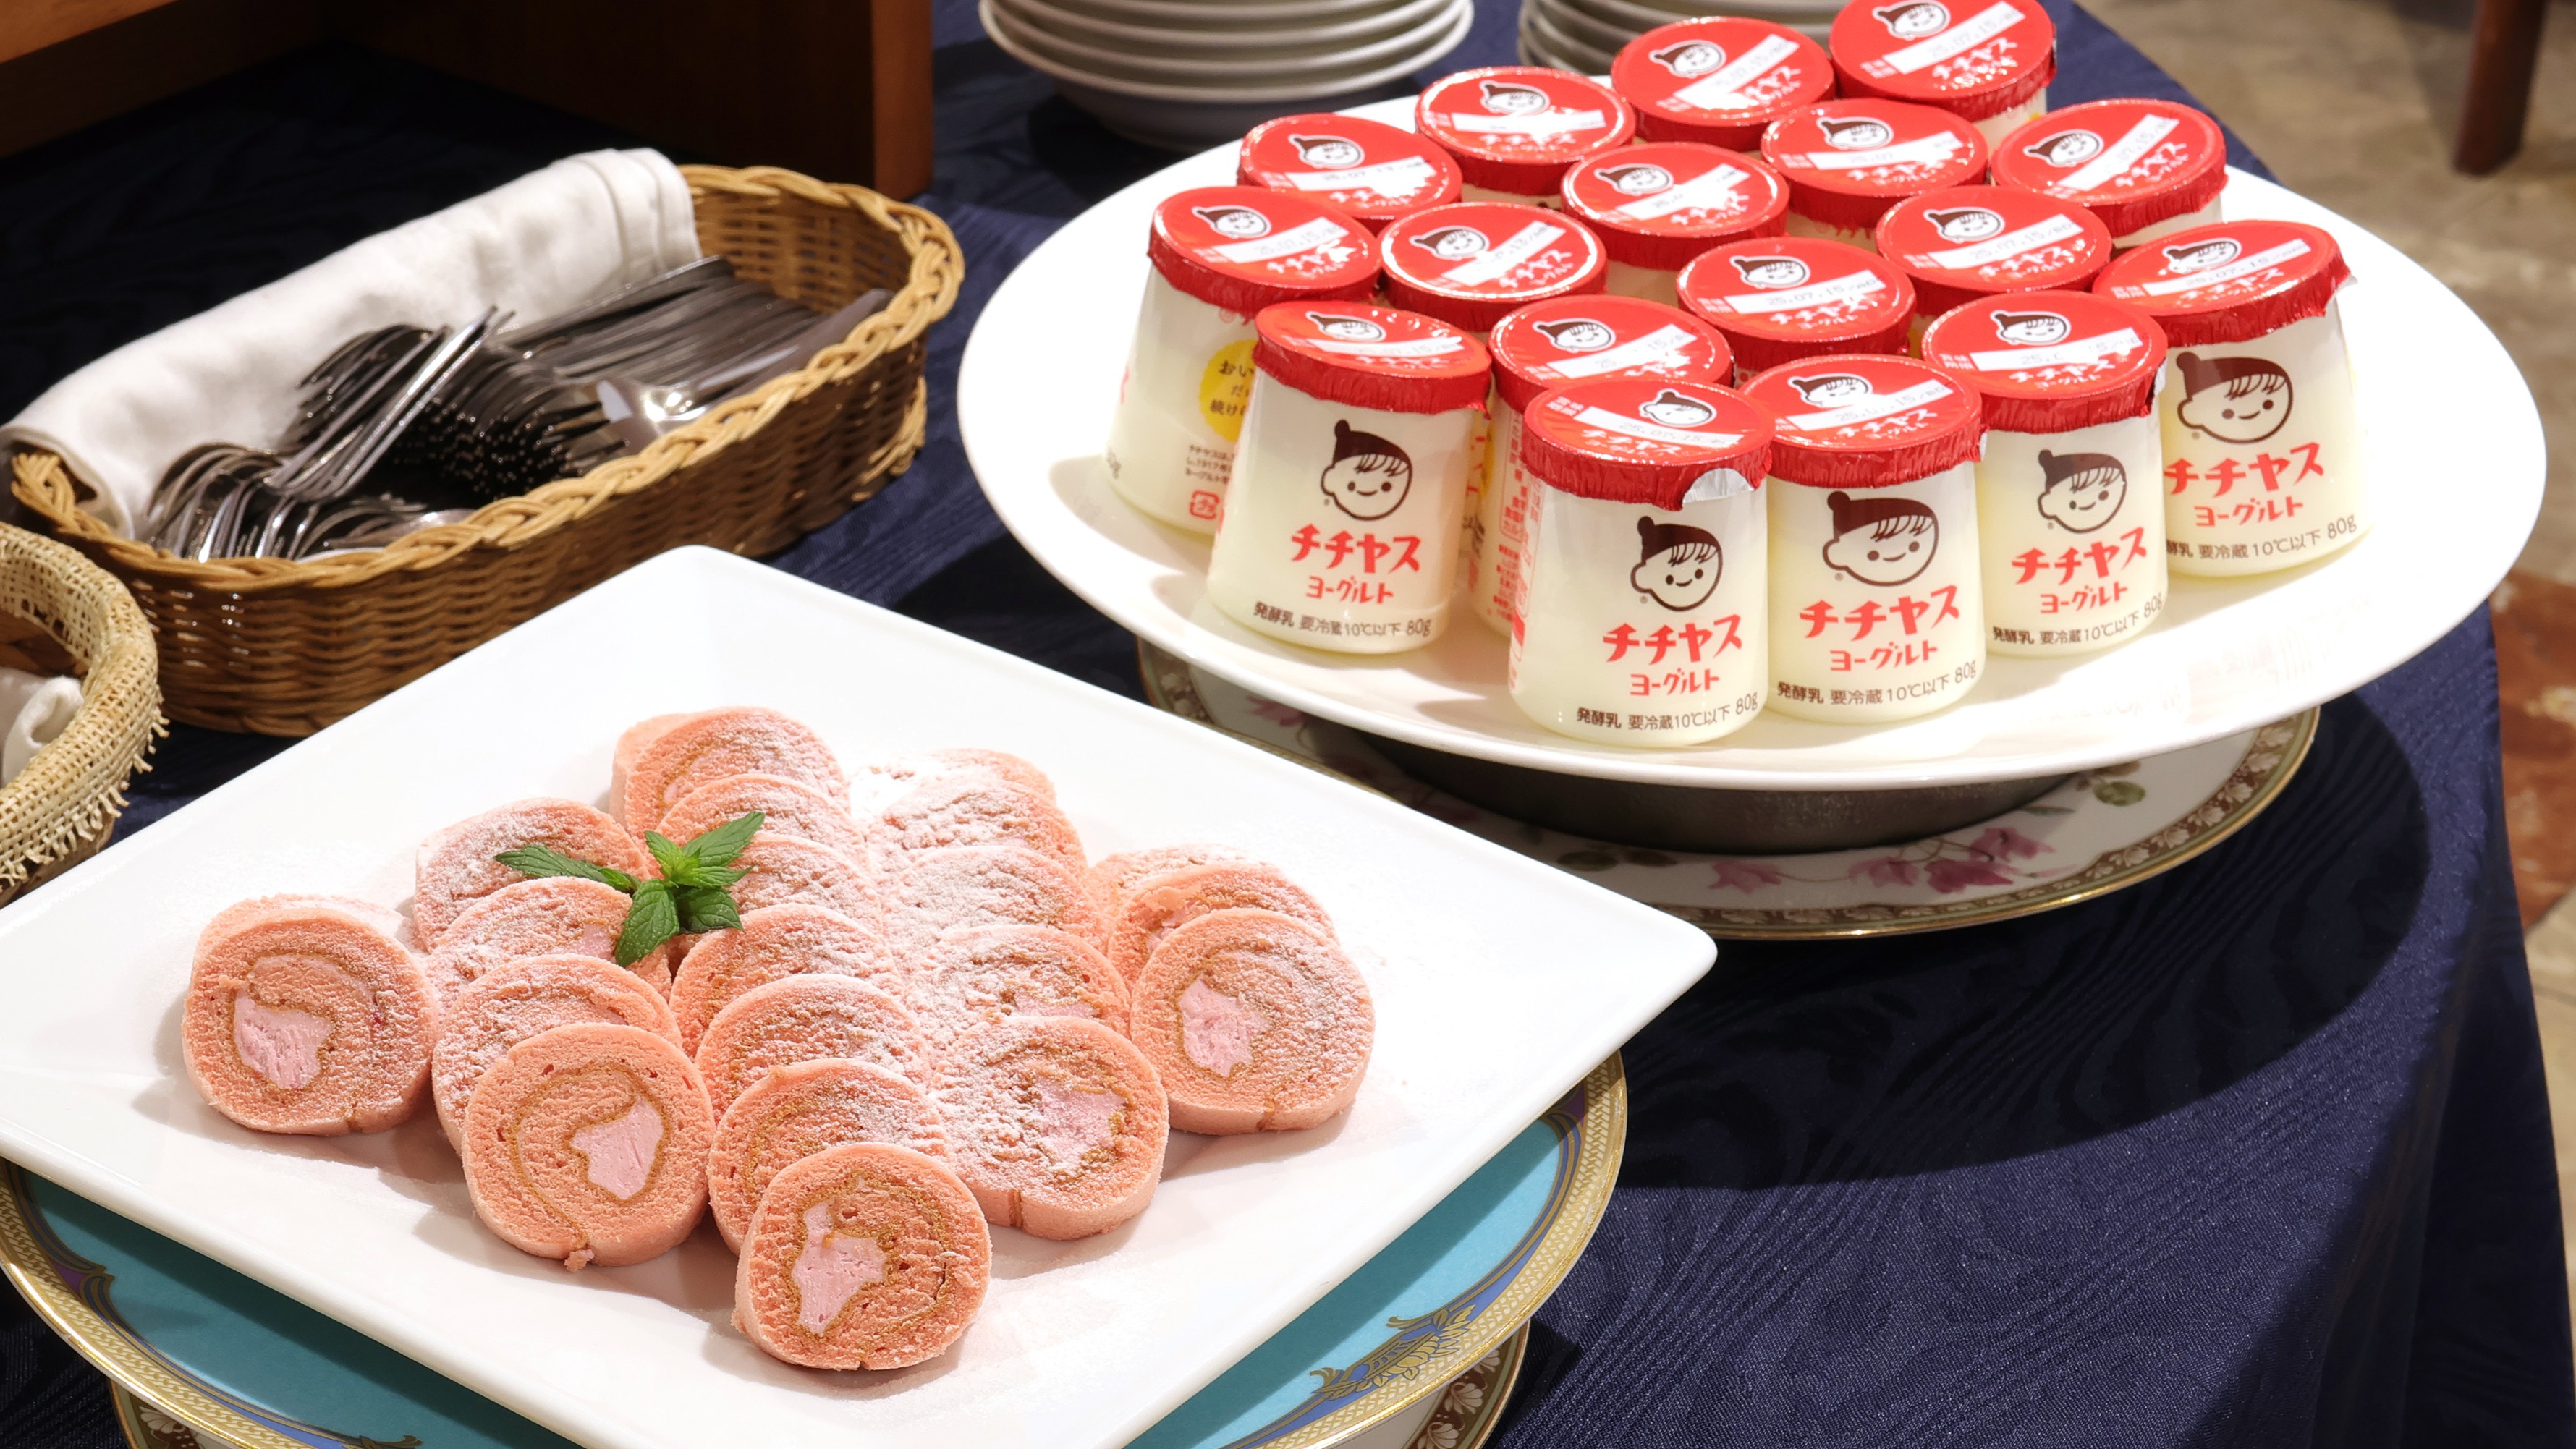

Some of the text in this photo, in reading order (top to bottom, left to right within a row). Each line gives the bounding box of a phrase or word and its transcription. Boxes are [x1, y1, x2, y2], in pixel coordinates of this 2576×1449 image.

[2009, 360, 2116, 383] チチヤス
[1836, 409, 1938, 438] チチヤス
[2163, 442, 2324, 498] チチヤス
[2194, 496, 2304, 527] ヨーグルト
[1291, 524, 1422, 573] チチヤス
[2166, 538, 2194, 558] 酵乳
[2327, 514, 2358, 540] 80g
[2012, 527, 2147, 585] チチヤス
[1305, 575, 1394, 604] ヨーグルト
[2040, 581, 2129, 614] ヨーグルト
[1799, 585, 1960, 642] チチヤス
[2143, 592, 2164, 619] 80g
[1406, 618, 1433, 637] 80g
[1602, 614, 1743, 665] チチヤス
[1829, 639, 1939, 672] ヨーグルト
[1630, 667, 1721, 697] ヨーグルト
[1955, 660, 1977, 684] 80g
[1735, 692, 1759, 716] 80g
